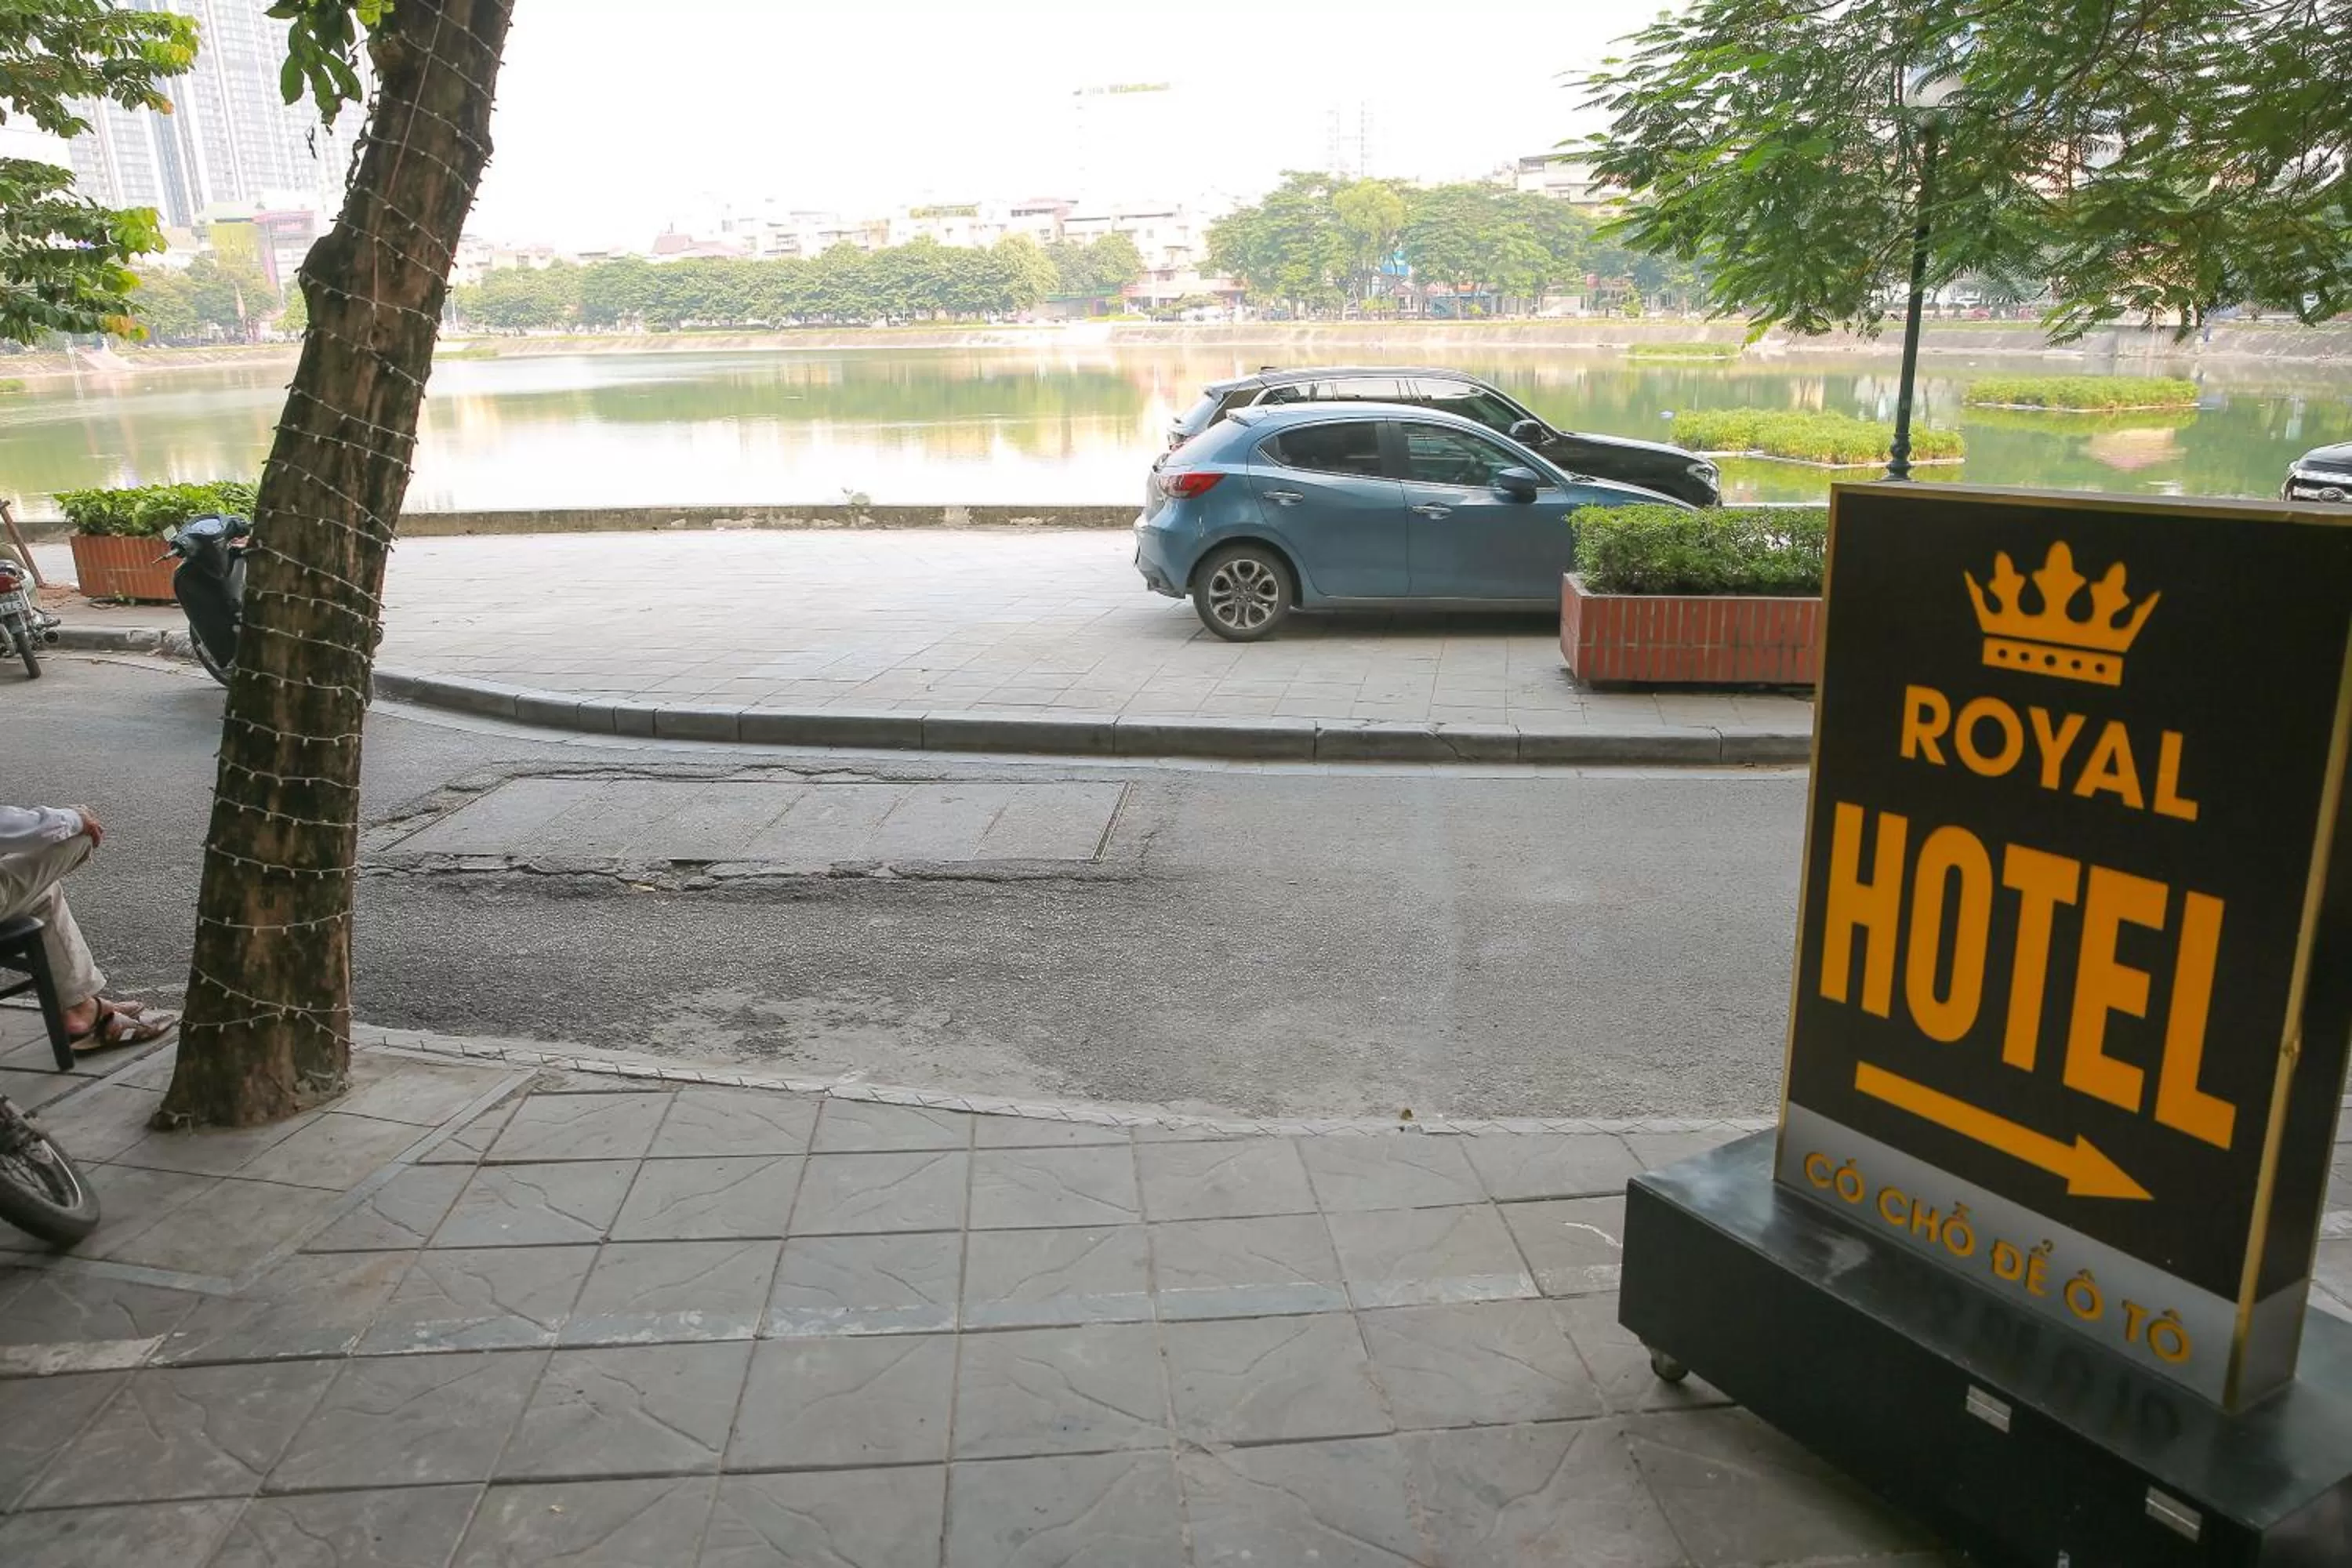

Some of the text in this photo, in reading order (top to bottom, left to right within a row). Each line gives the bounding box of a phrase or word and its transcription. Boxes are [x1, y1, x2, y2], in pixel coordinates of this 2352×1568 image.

[1901, 685, 2198, 821] ROYAL
[1820, 802, 2236, 1150] HOTEL
[1805, 1151, 1865, 1205] CÓ
[1991, 1239, 2054, 1298] ĐỂ
[2063, 1268, 2104, 1323] Ô
[2121, 1298, 2192, 1365] TÔ
